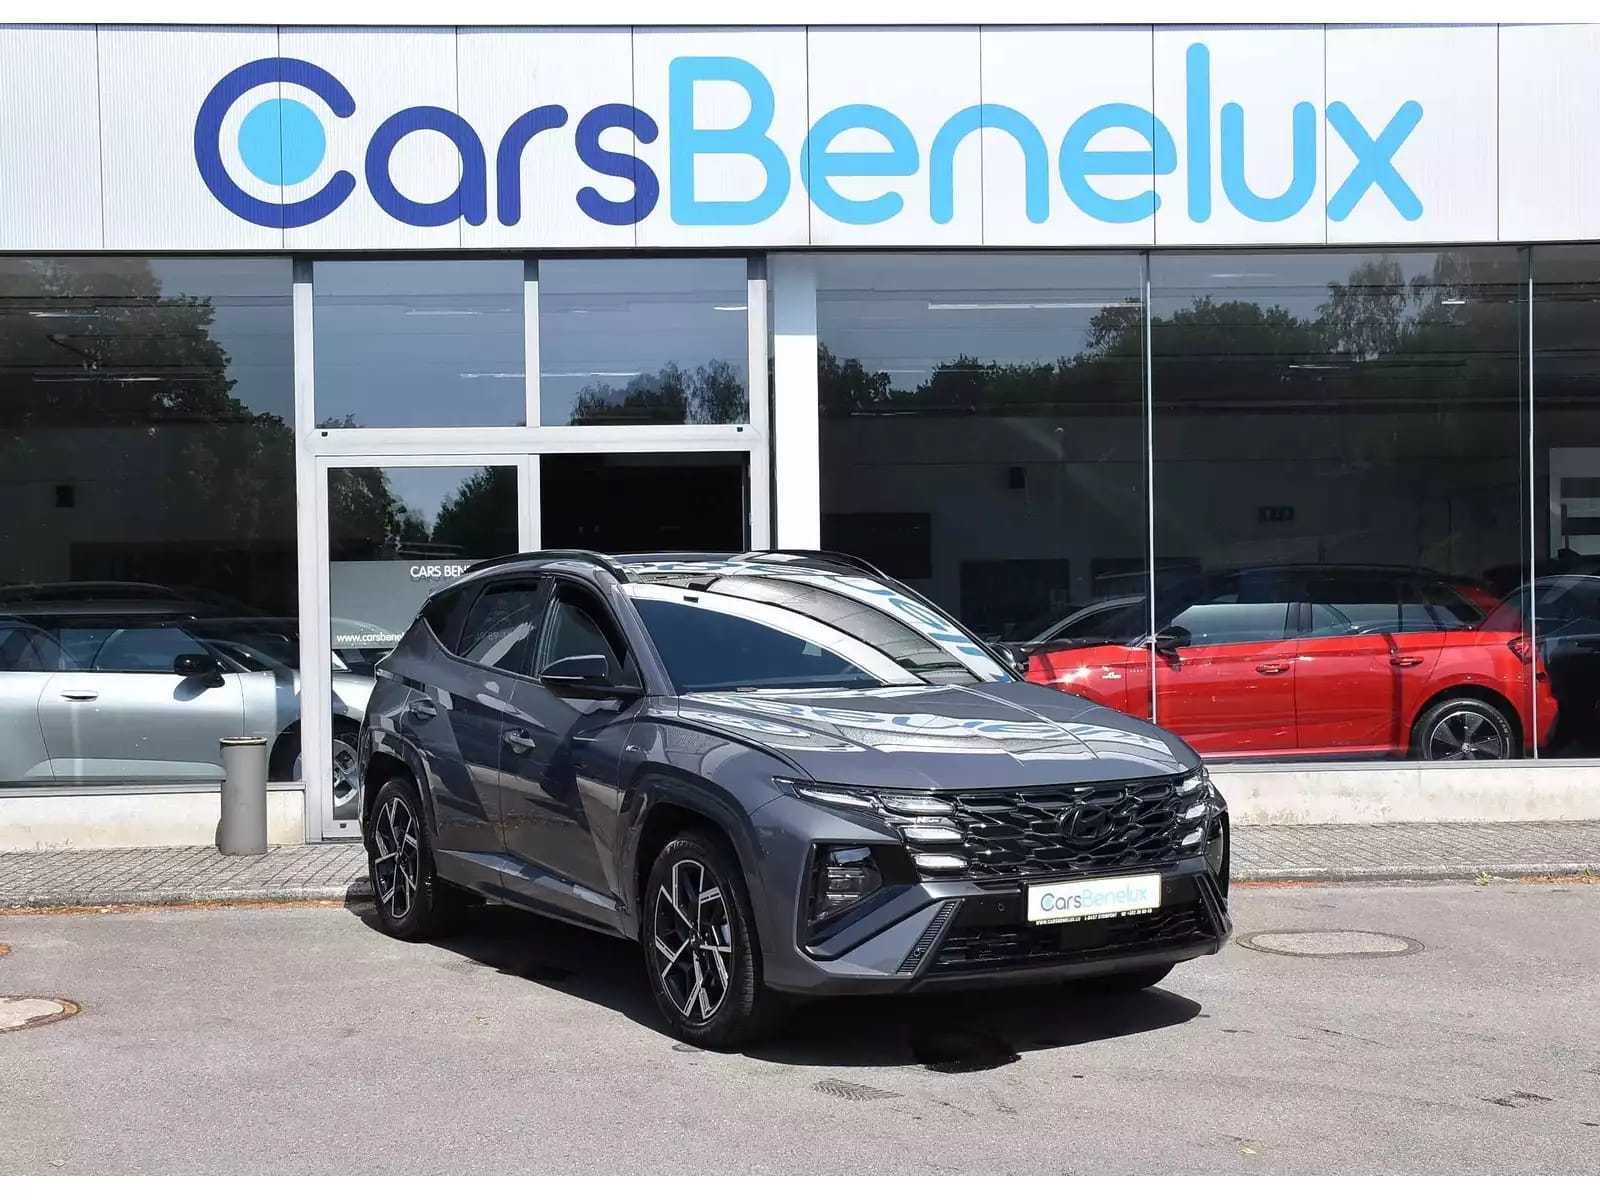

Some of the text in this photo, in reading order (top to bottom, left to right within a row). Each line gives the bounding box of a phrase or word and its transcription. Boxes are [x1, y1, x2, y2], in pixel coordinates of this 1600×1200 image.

[194, 42, 1423, 229] CarsBenelux
[409, 565, 471, 577] CARS BEN
[1040, 883, 1149, 912] CarsBenelux
